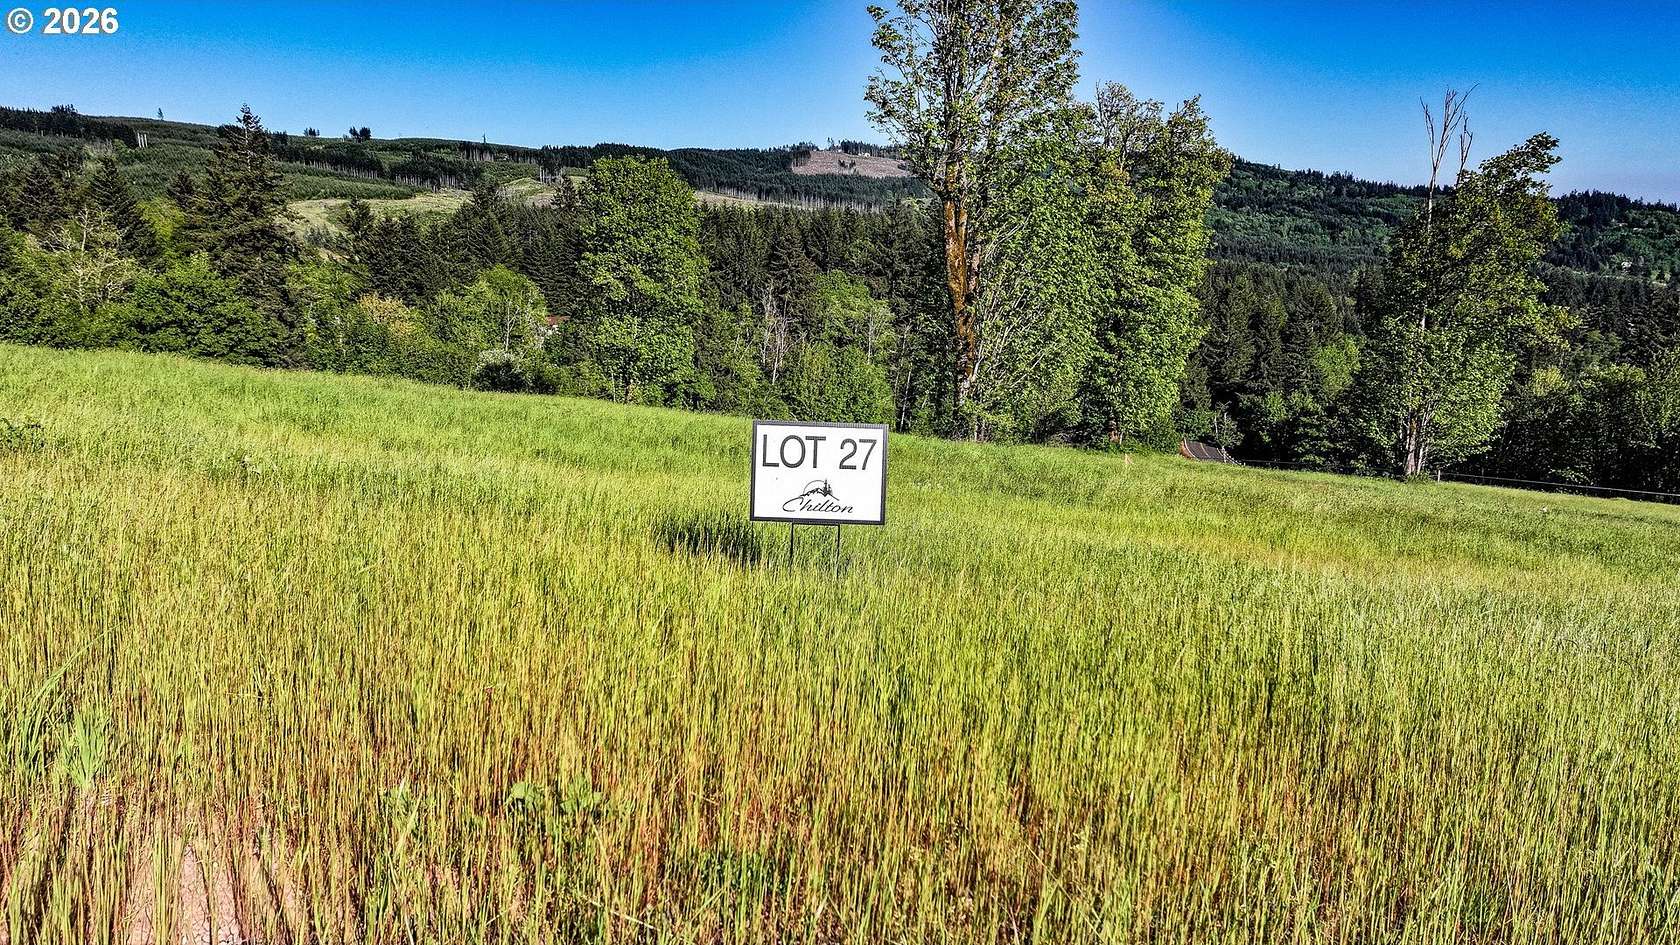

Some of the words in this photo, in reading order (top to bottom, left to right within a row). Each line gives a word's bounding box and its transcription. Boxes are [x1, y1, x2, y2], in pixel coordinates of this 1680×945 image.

[762, 434, 827, 469] LOT
[839, 438, 878, 471] 27
[782, 496, 854, 514] Chilton
